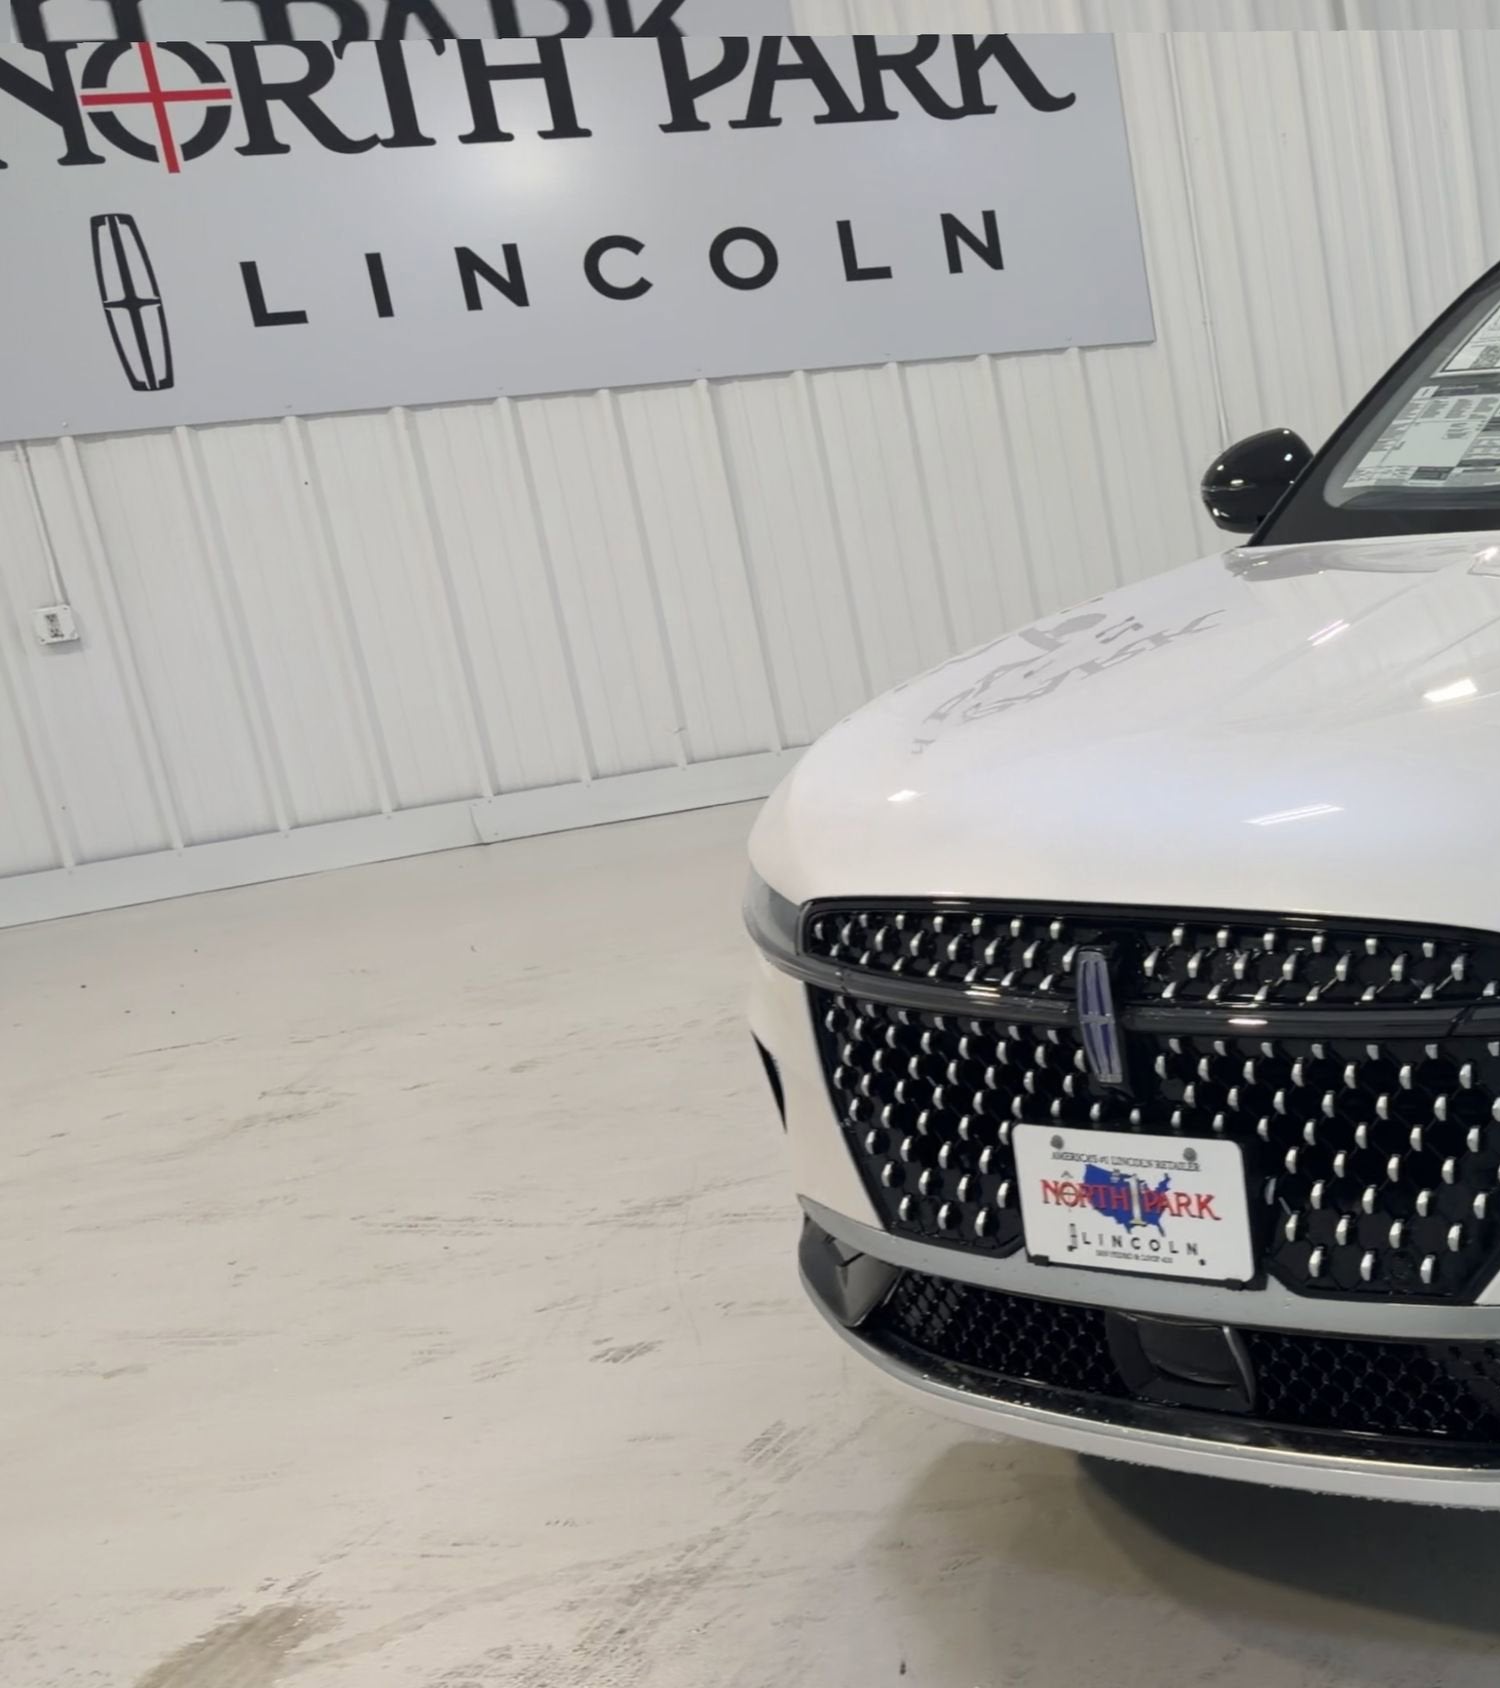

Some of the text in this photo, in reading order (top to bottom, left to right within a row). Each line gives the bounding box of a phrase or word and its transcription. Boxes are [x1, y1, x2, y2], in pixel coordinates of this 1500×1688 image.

[658, 35, 1076, 133] PARK
[240, 210, 1004, 327] LINCOLN
[1041, 1179, 1222, 1220] NORTH PARK
[1081, 1232, 1198, 1255] LINCOLN
